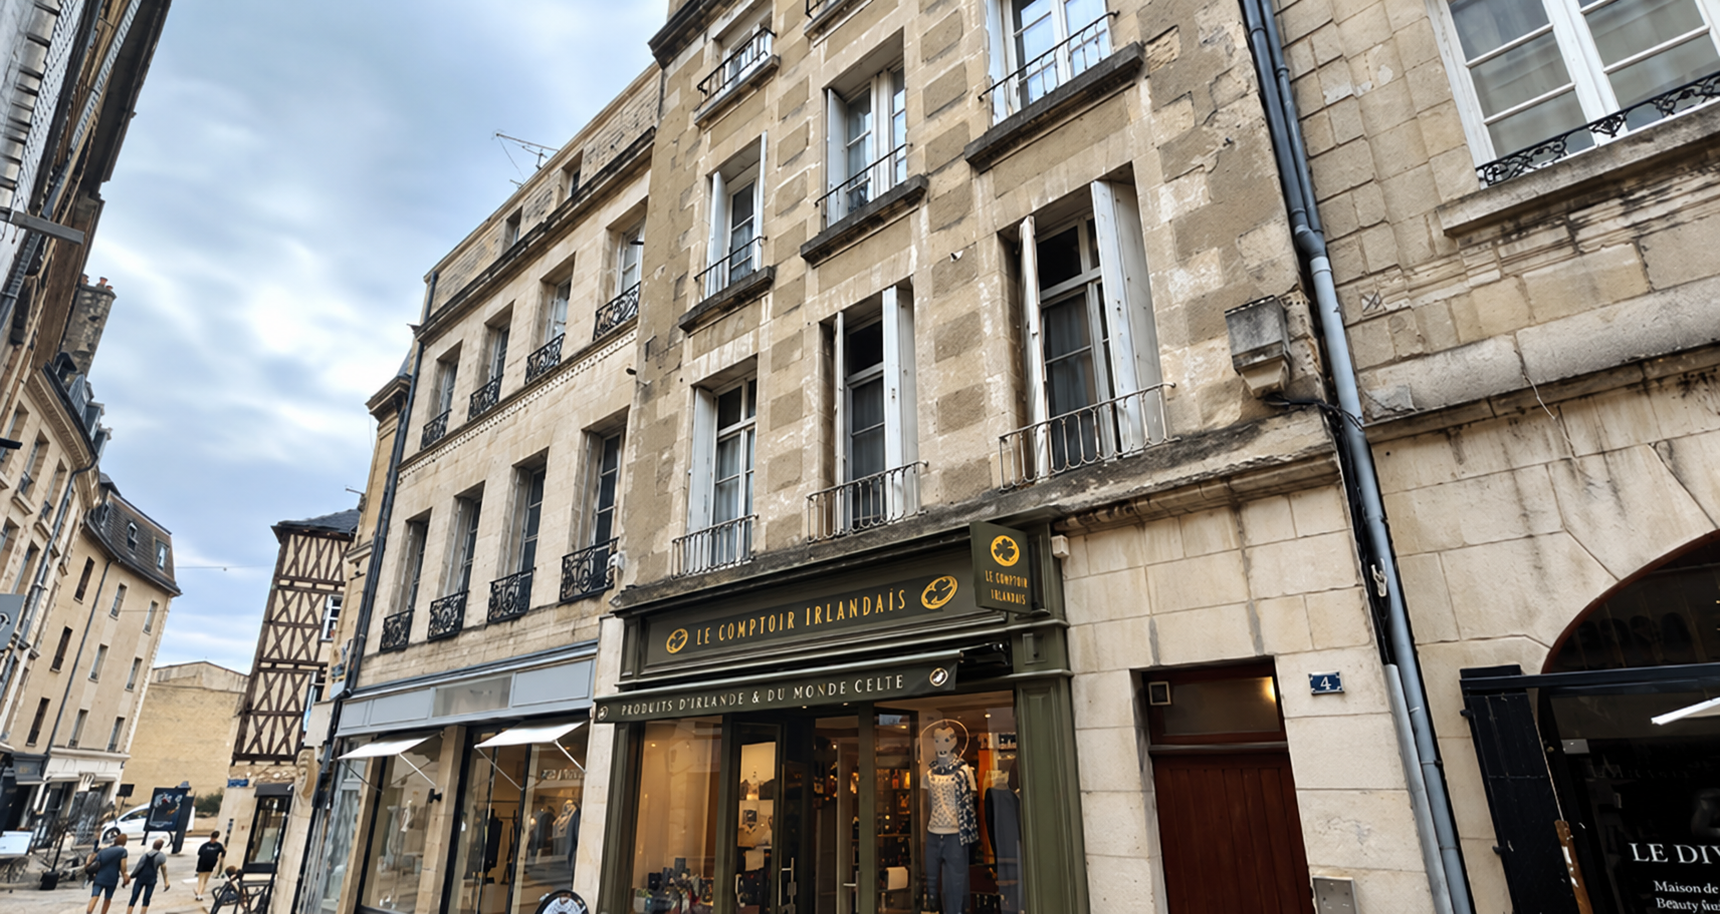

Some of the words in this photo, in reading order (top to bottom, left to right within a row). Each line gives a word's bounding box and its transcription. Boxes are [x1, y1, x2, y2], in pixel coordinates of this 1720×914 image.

[985, 570, 993, 582] LE
[697, 627, 711, 645] LE
[718, 611, 795, 641] COMPTOIR
[1320, 676, 1332, 690] 4
[621, 700, 673, 716] PRODUITS
[679, 692, 744, 711] D'IRLANDE
[751, 690, 760, 704] &
[768, 688, 785, 701] DU
[793, 681, 846, 699] MONDE
[855, 674, 904, 693] CELTE
[1628, 842, 1669, 863] LE
[1653, 880, 1702, 893] Maison
[1703, 882, 1719, 894] de
[1656, 897, 1698, 914] Beauty
